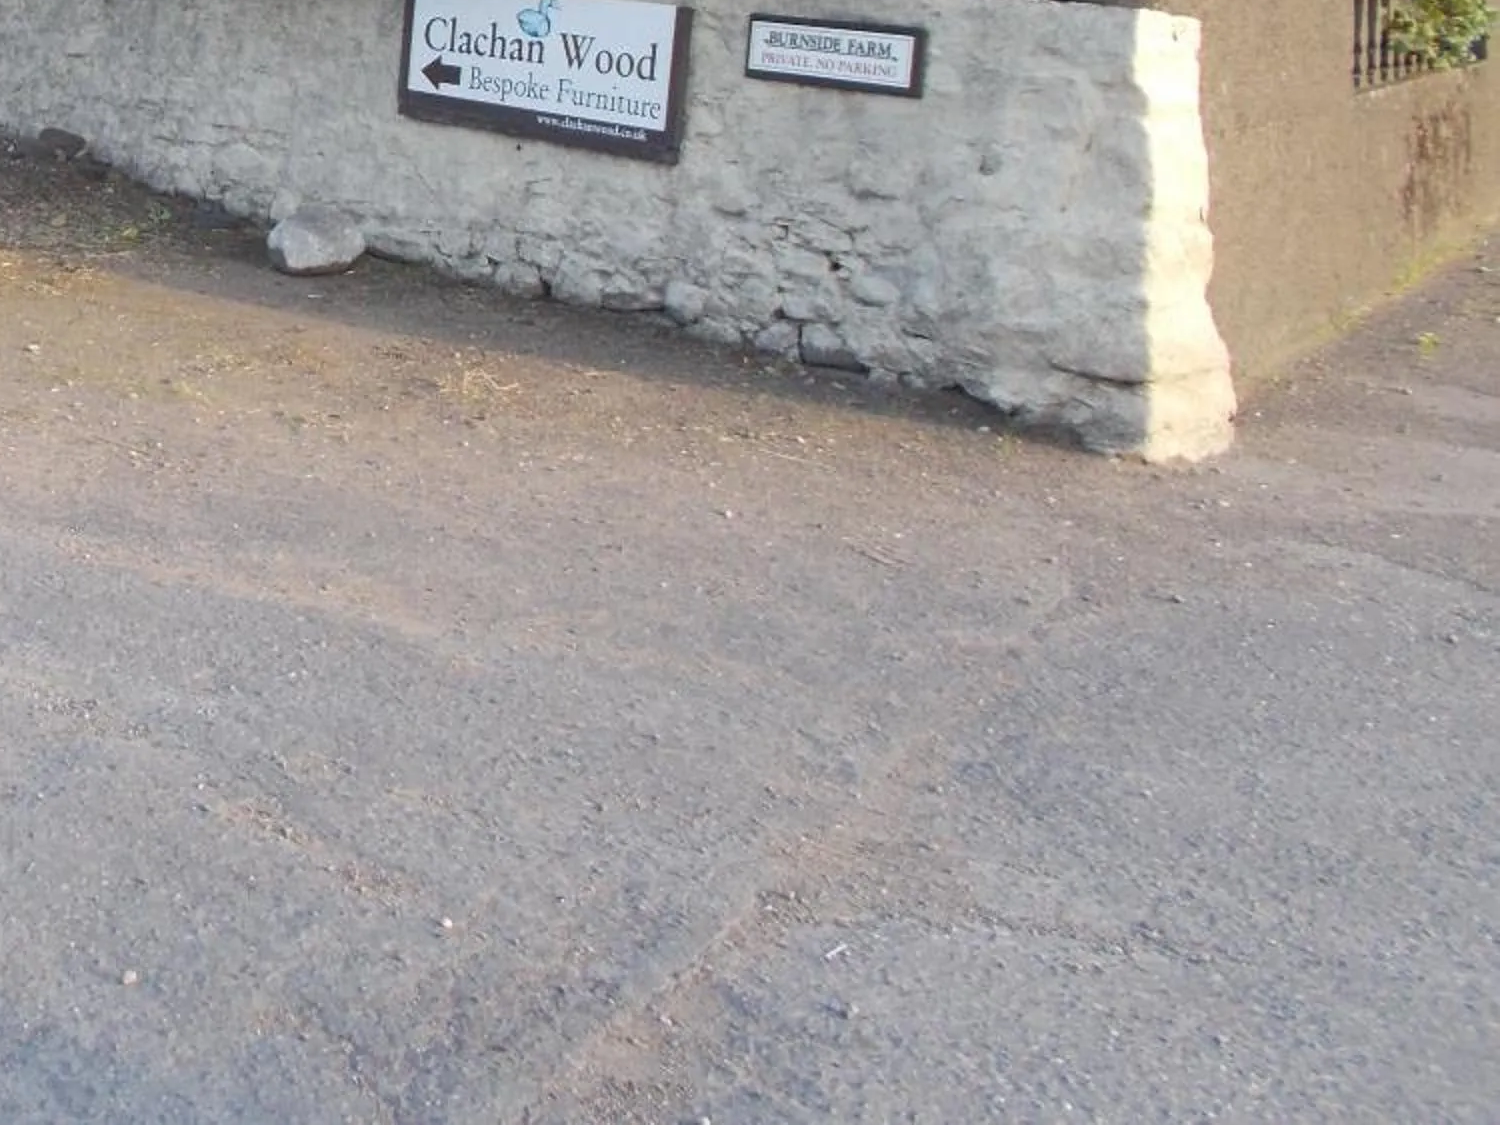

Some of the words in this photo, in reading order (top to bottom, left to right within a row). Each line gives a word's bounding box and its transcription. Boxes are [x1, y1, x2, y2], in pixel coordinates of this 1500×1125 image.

[424, 16, 545, 64] Clachan
[560, 32, 658, 81] Wood
[769, 31, 841, 51] BURNSIDE
[847, 39, 892, 58] FARM
[837, 60, 897, 76] PARKING
[468, 66, 550, 102] Bespoke
[556, 78, 661, 120] Furniture
